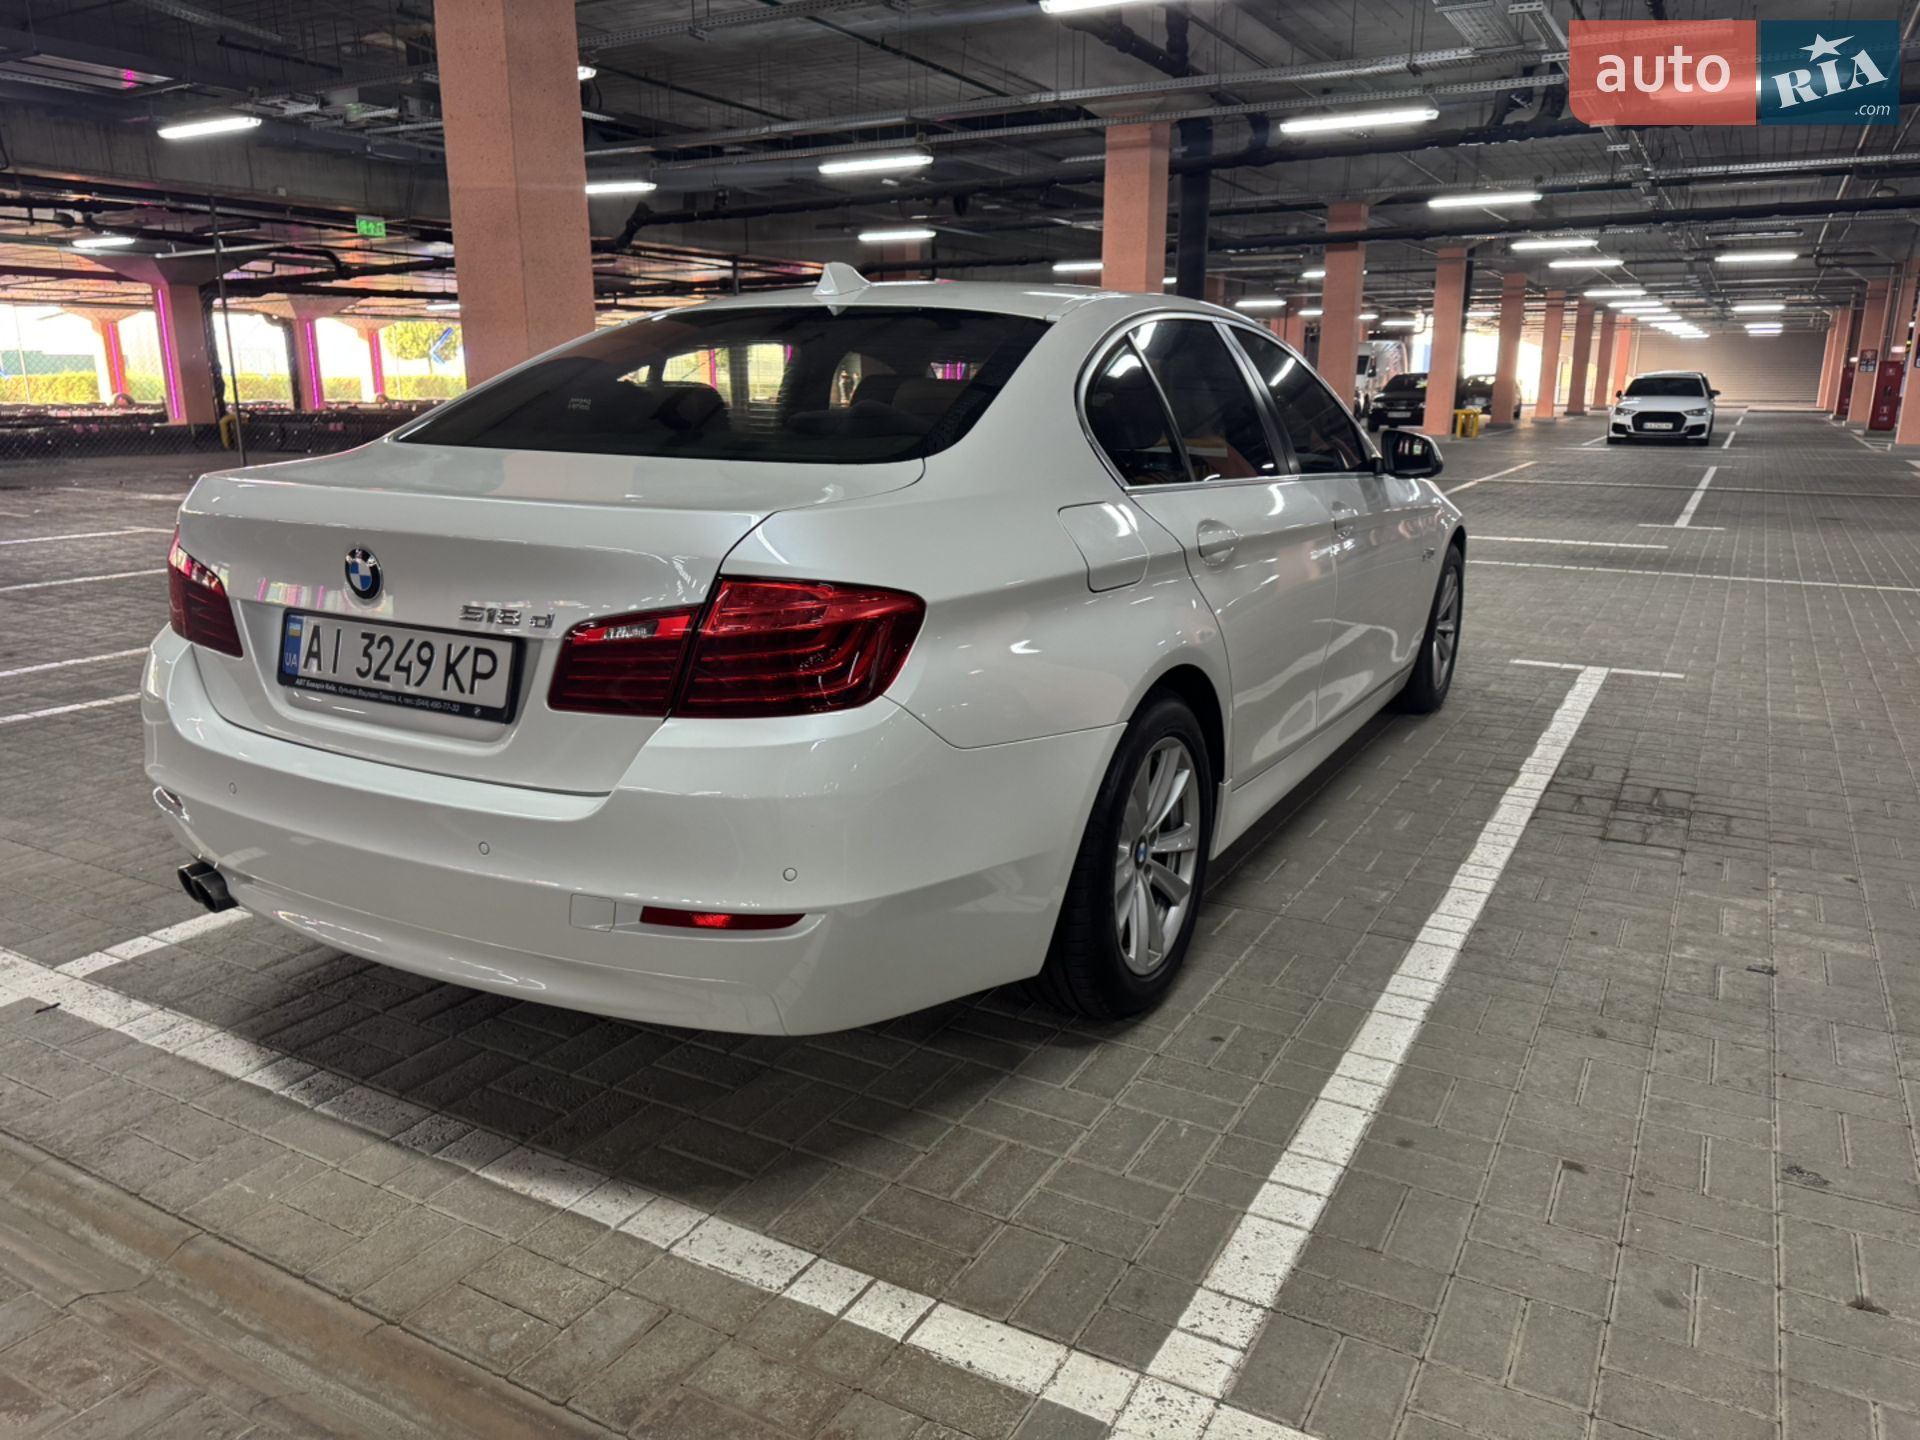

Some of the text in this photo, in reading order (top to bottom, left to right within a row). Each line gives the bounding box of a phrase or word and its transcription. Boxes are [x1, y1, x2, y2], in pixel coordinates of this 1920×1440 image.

[459, 605, 555, 629] 518 d
[284, 652, 299, 667] UA
[302, 624, 498, 695] AI 3249 KP
